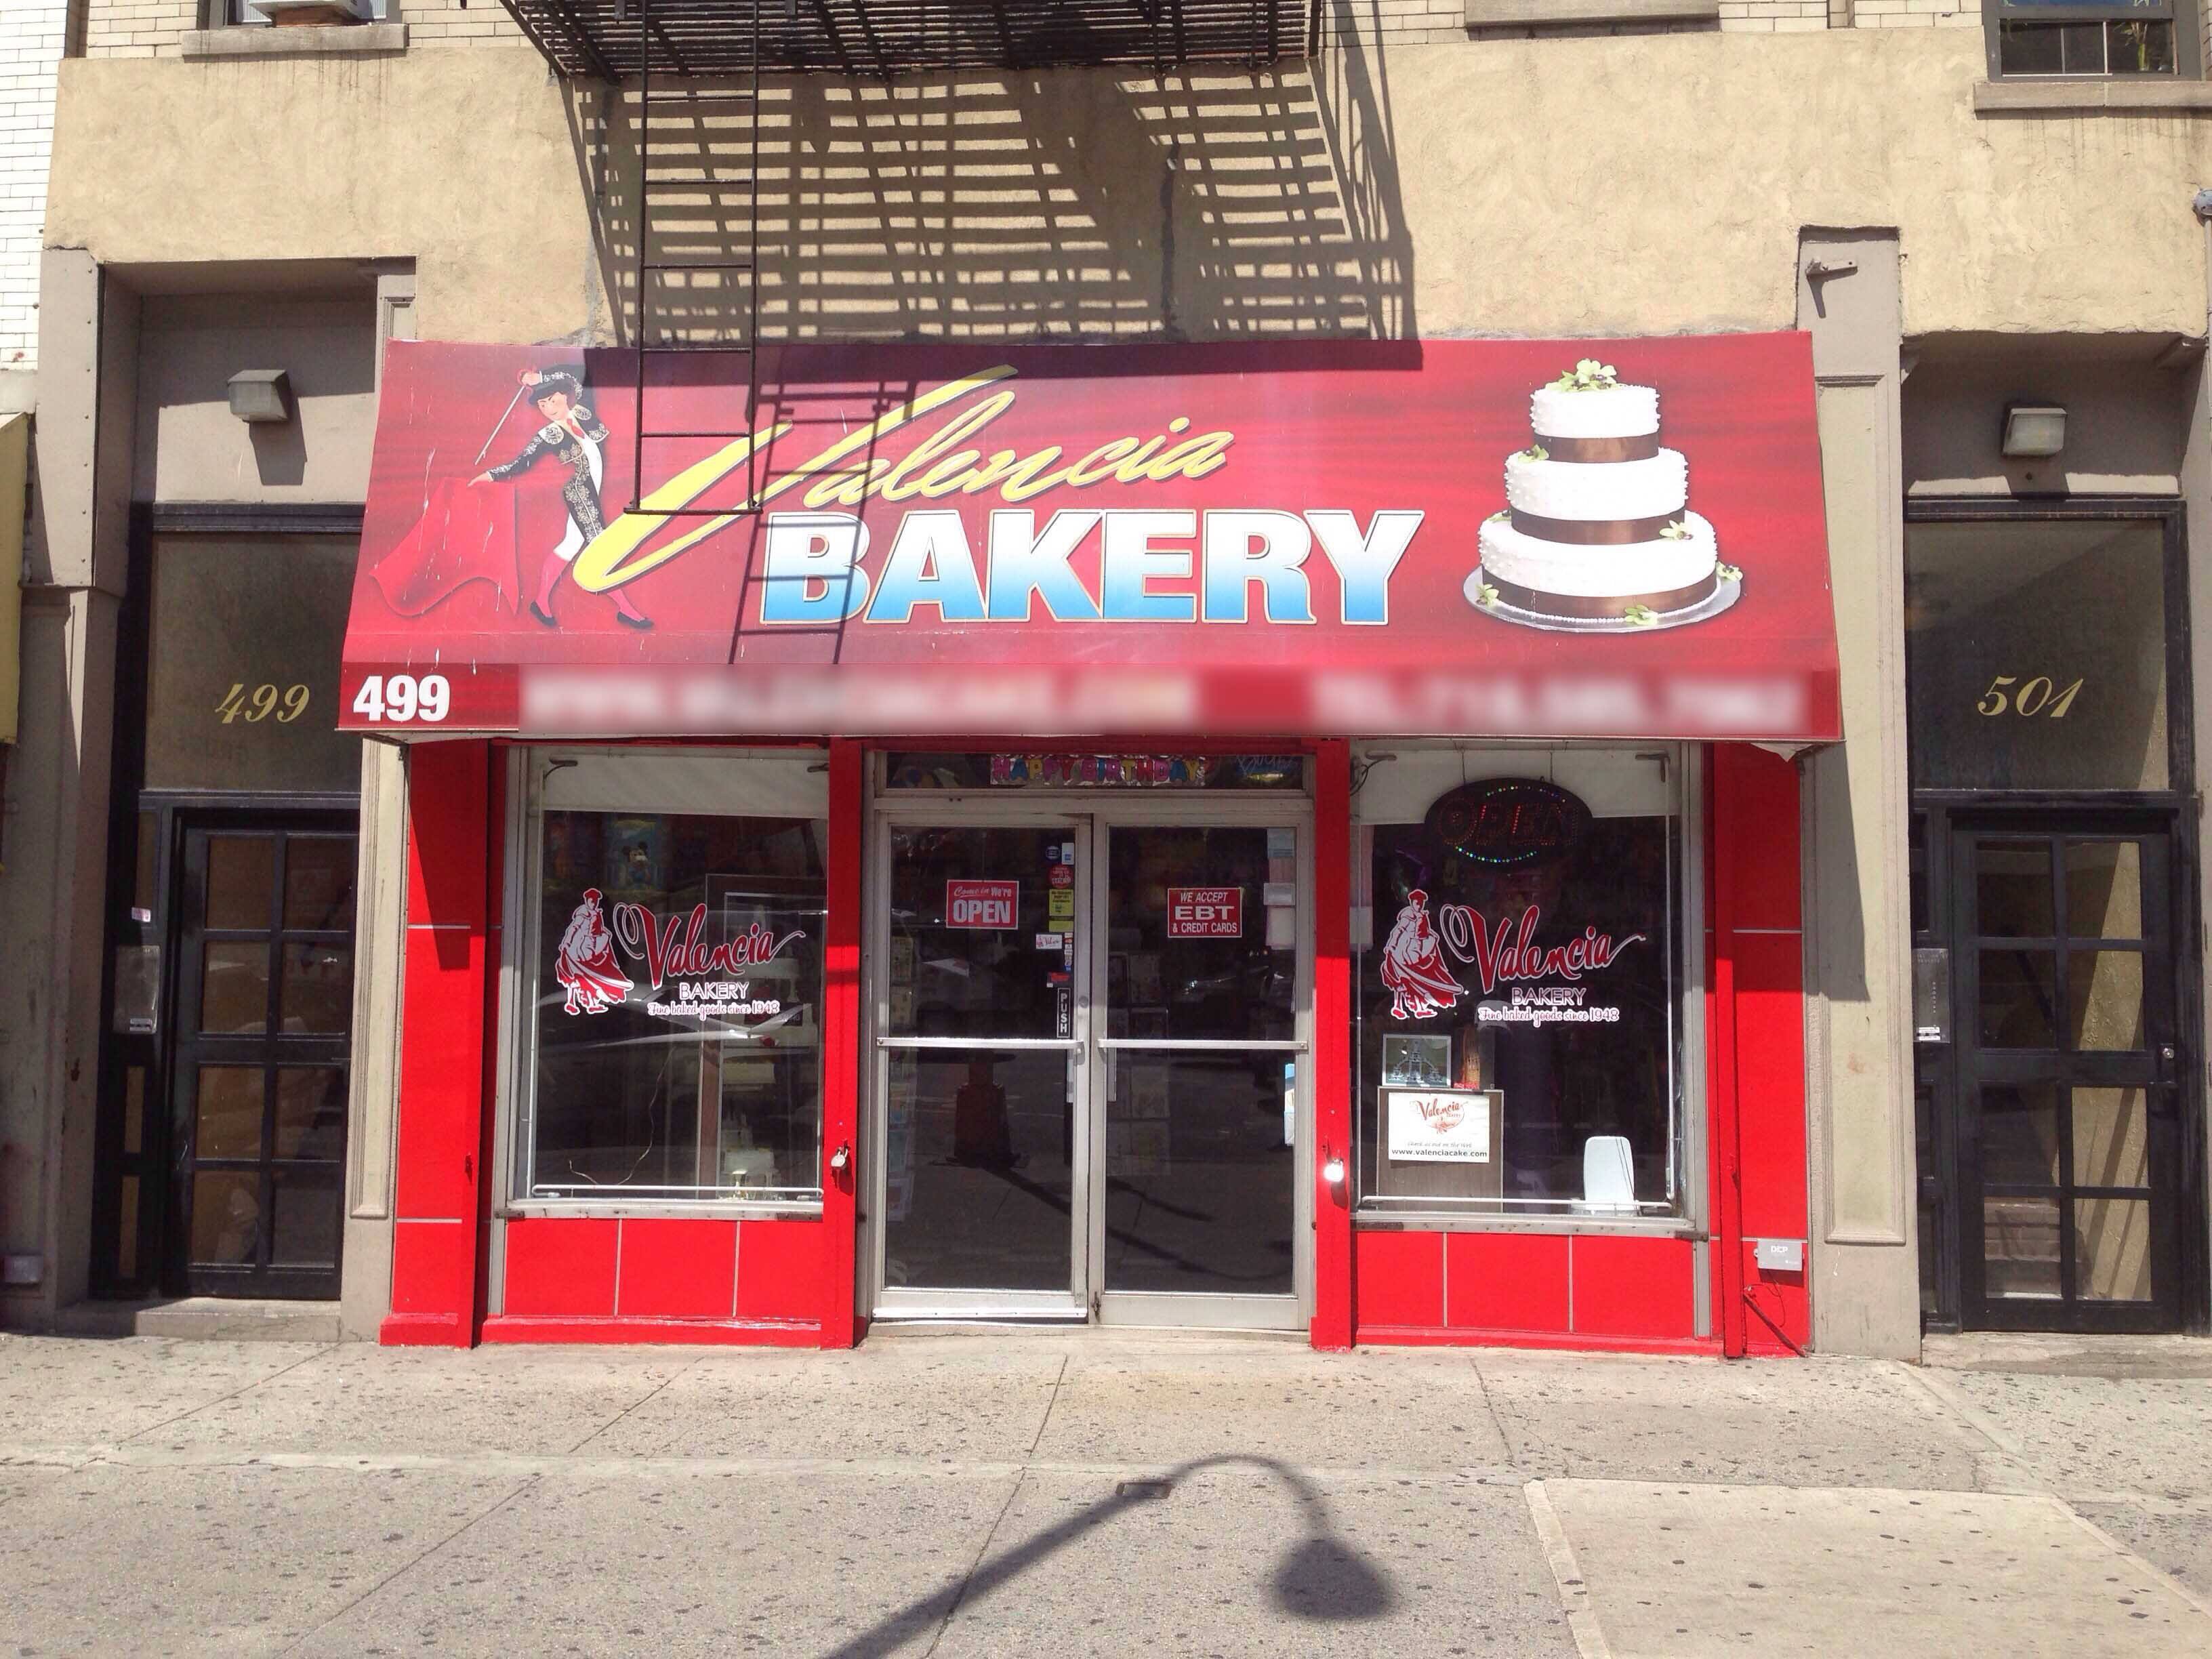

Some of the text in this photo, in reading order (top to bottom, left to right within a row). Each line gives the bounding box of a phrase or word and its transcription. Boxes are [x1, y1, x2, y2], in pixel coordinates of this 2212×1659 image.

[573, 365, 1234, 594] Valencia
[760, 509, 1425, 626] BAKERY
[214, 683, 310, 724] 499
[352, 675, 451, 722] 499
[1976, 676, 2085, 718] 501
[992, 756, 1075, 781] HAPPY
[1181, 892, 1229, 902] WE ACCEPT
[953, 899, 1011, 924] OPEN
[1174, 905, 1235, 920] EBT
[1172, 922, 1237, 933] & CREDIT CARDS
[613, 902, 806, 991] Valencia
[1439, 903, 1647, 995] Valencia
[679, 981, 750, 1000] BAKERY
[1511, 987, 1587, 1006] BAKERY
[648, 1000, 781, 1021] Fine baked goods since 1948
[1060, 993, 1068, 1033] PUSH
[1478, 1006, 1620, 1028] Fine baked goods since 1948
[1412, 1098, 1468, 1121] Valencia
[1391, 1149, 1488, 1158] www.valenciacake.com
